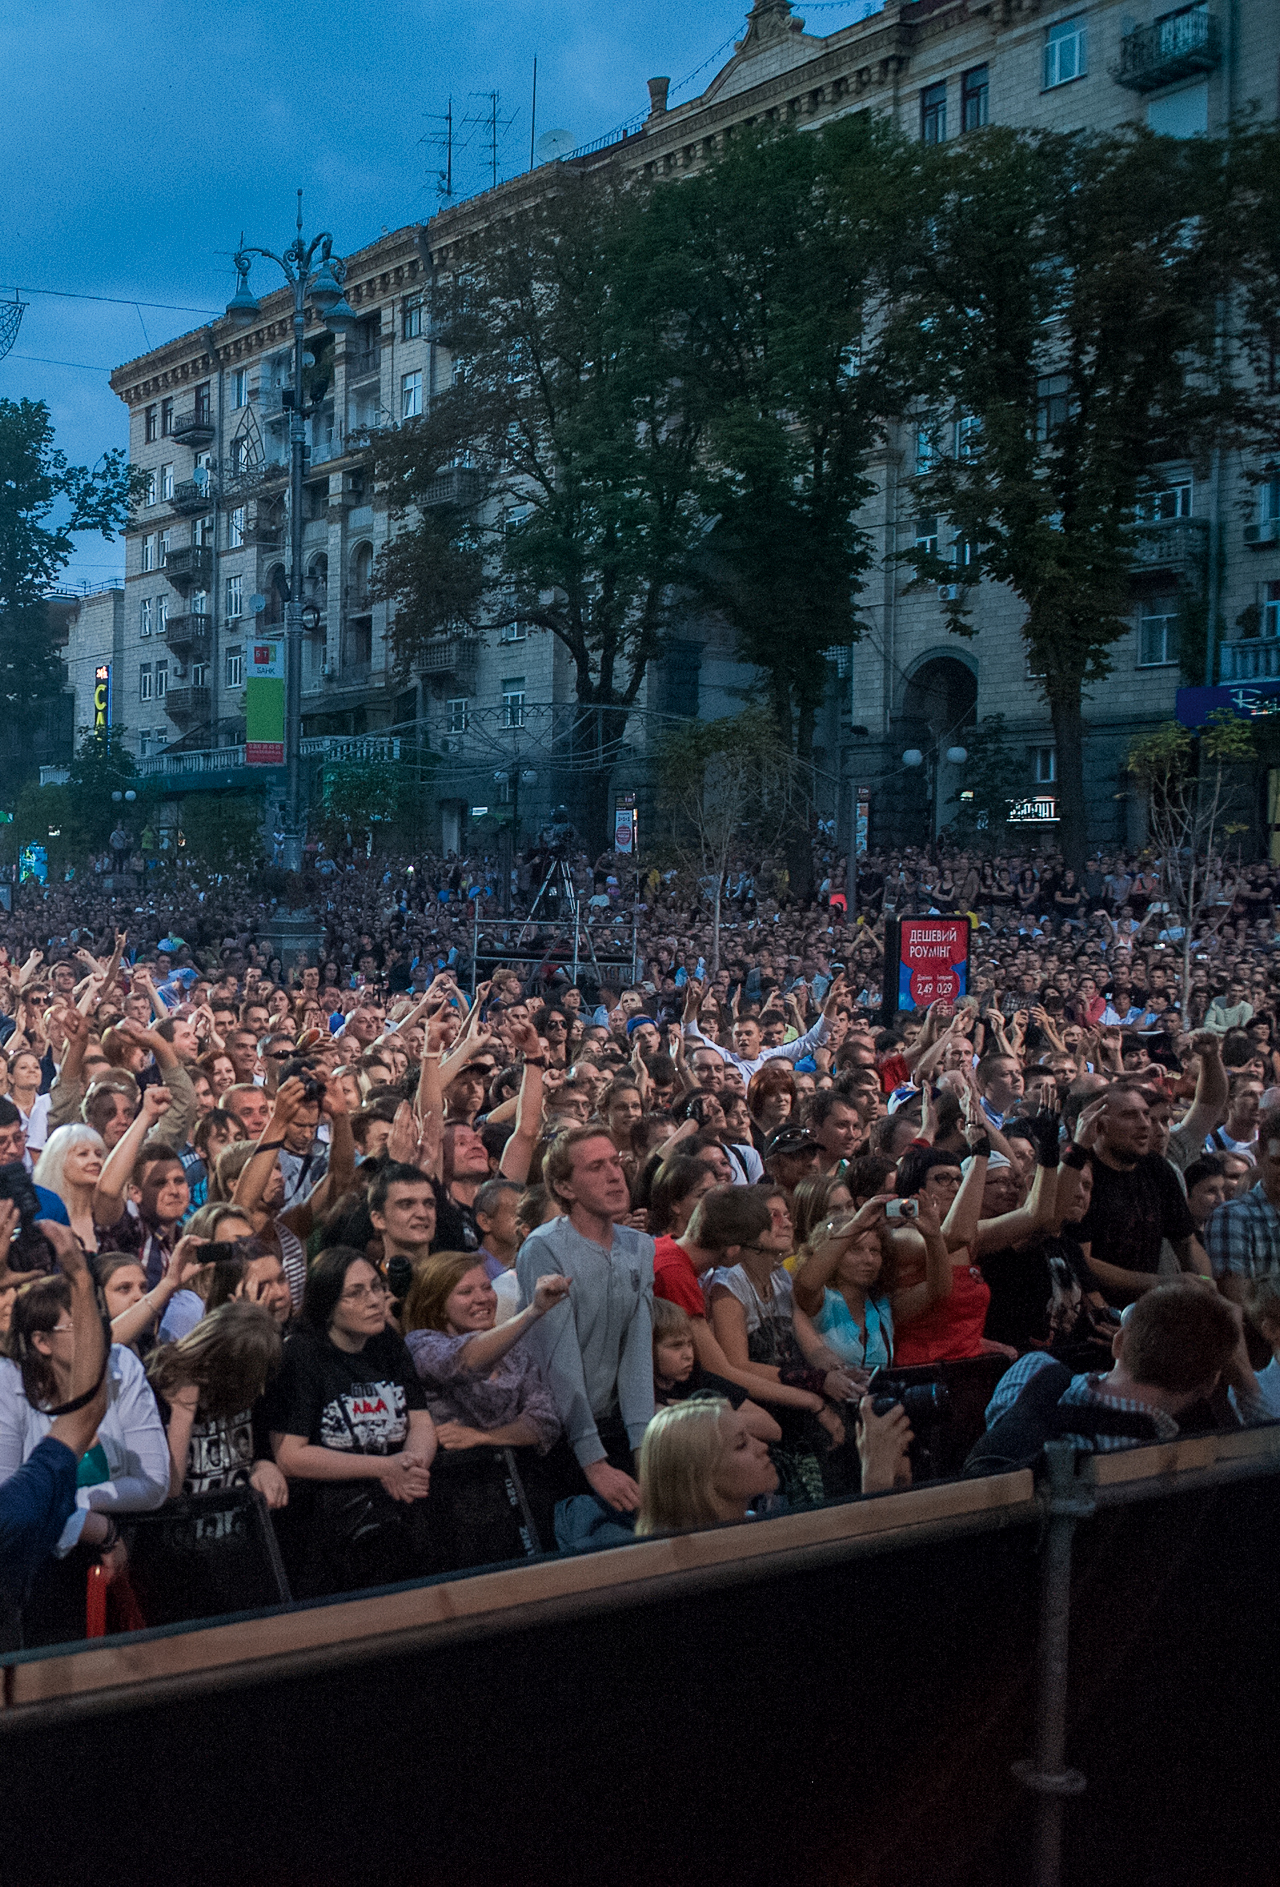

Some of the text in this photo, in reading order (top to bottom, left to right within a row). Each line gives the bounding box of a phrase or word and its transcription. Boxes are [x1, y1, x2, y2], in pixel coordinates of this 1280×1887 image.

[909, 927, 957, 944] ДЕШЕВИЙ
[909, 945, 952, 958] РОУМІНГ
[917, 982, 953, 995] 2,49 0,29
